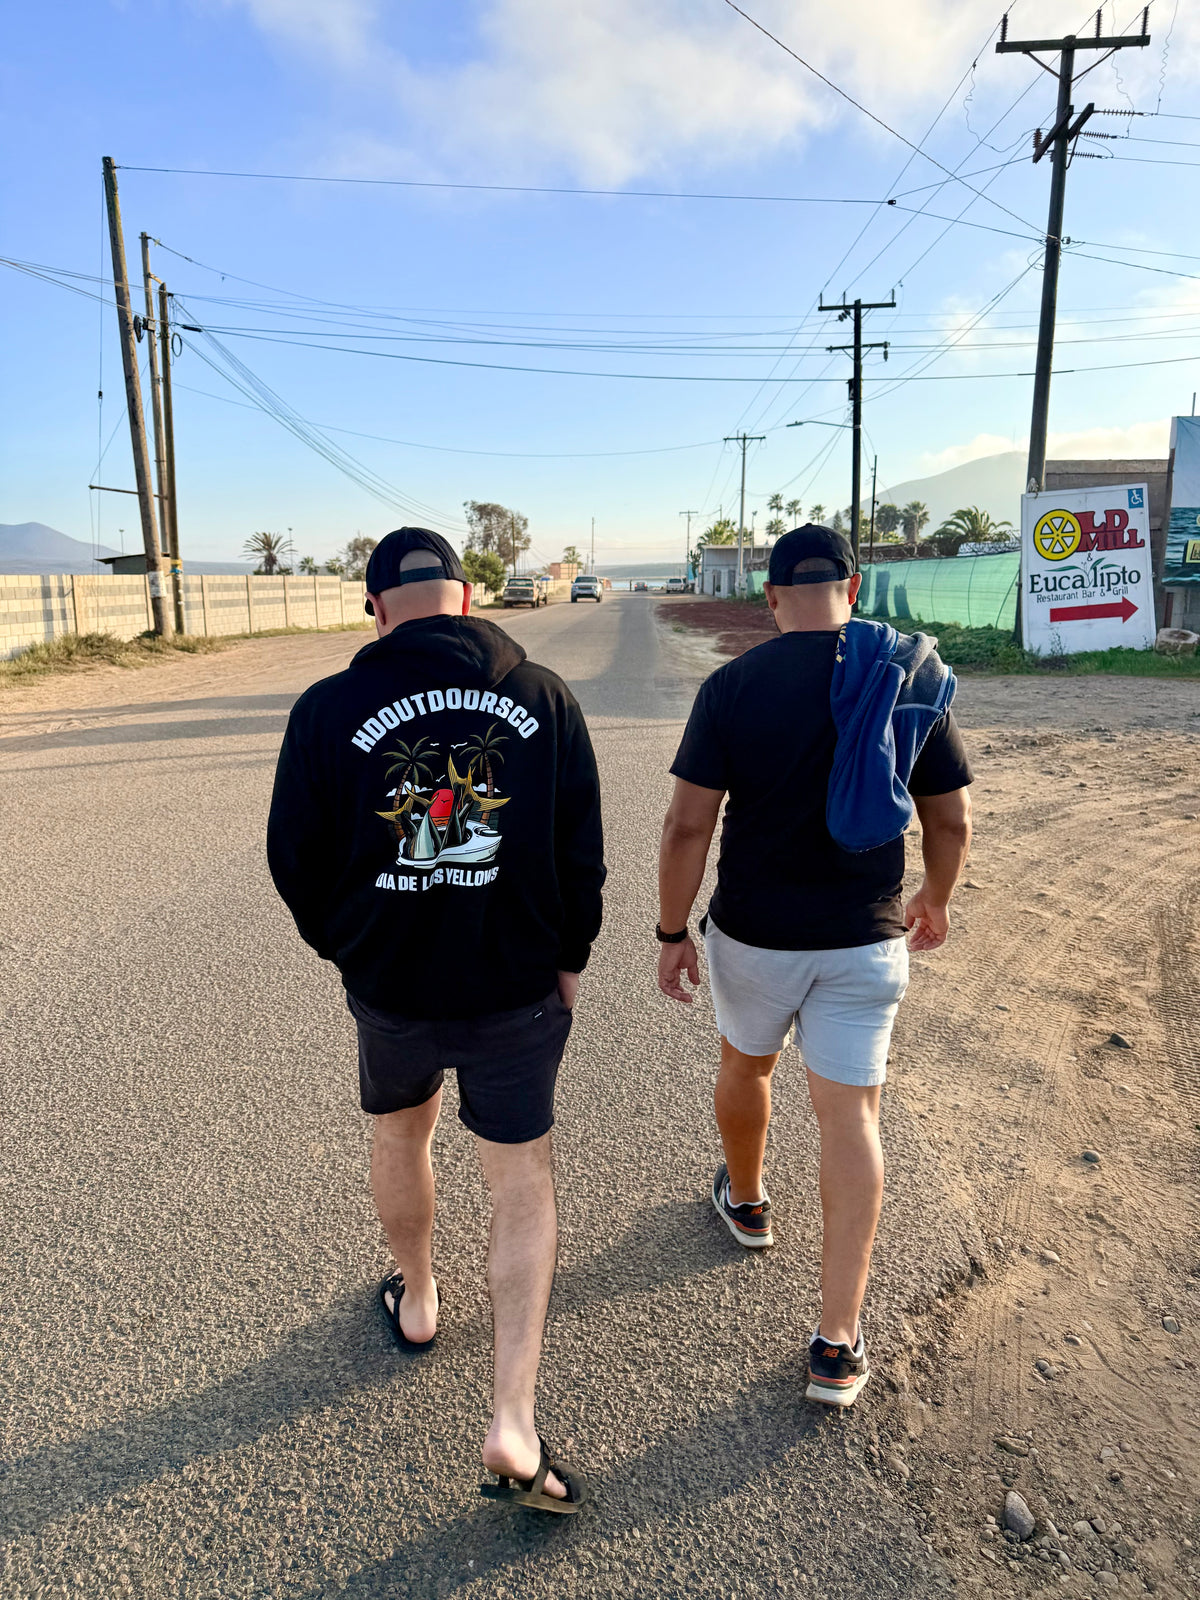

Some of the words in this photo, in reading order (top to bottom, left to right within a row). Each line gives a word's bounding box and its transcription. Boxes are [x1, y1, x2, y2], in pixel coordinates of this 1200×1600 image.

[1077, 529, 1145, 552] MILL
[1029, 565, 1142, 594] Eucalipto
[1036, 592, 1079, 603] Restaurant
[1082, 590, 1096, 599] Bar
[1099, 588, 1106, 597] &
[1112, 586, 1129, 596] Grill
[351, 687, 540, 753] HDOUTDOORSCO
[375, 872, 397, 891] DIA
[398, 875, 418, 892] DE
[445, 866, 500, 887] YELLOWS
